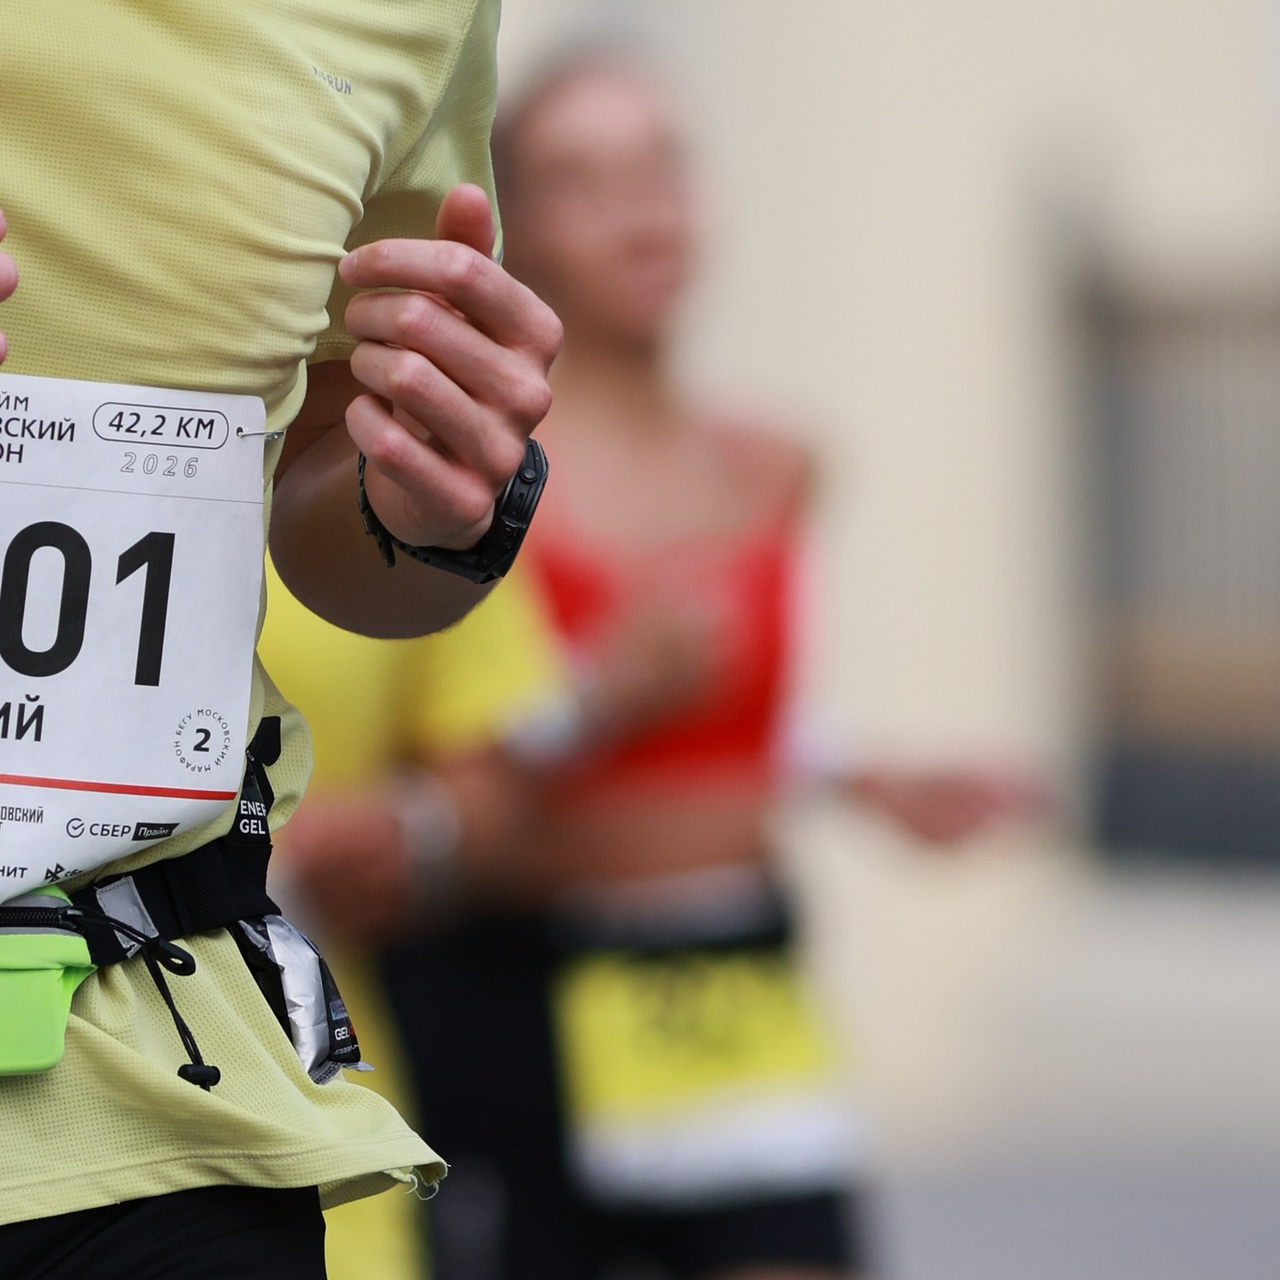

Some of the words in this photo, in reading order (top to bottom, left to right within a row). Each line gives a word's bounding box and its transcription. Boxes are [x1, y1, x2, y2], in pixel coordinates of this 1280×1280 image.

[108, 411, 167, 438] 42,2
[120, 451, 199, 478] 2026
[175, 712, 193, 737] БЕГУ
[192, 727, 211, 753] 2
[174, 740, 212, 773] МАРАФОН
[89, 823, 132, 837] СБЕР
[239, 818, 266, 835] GEL
